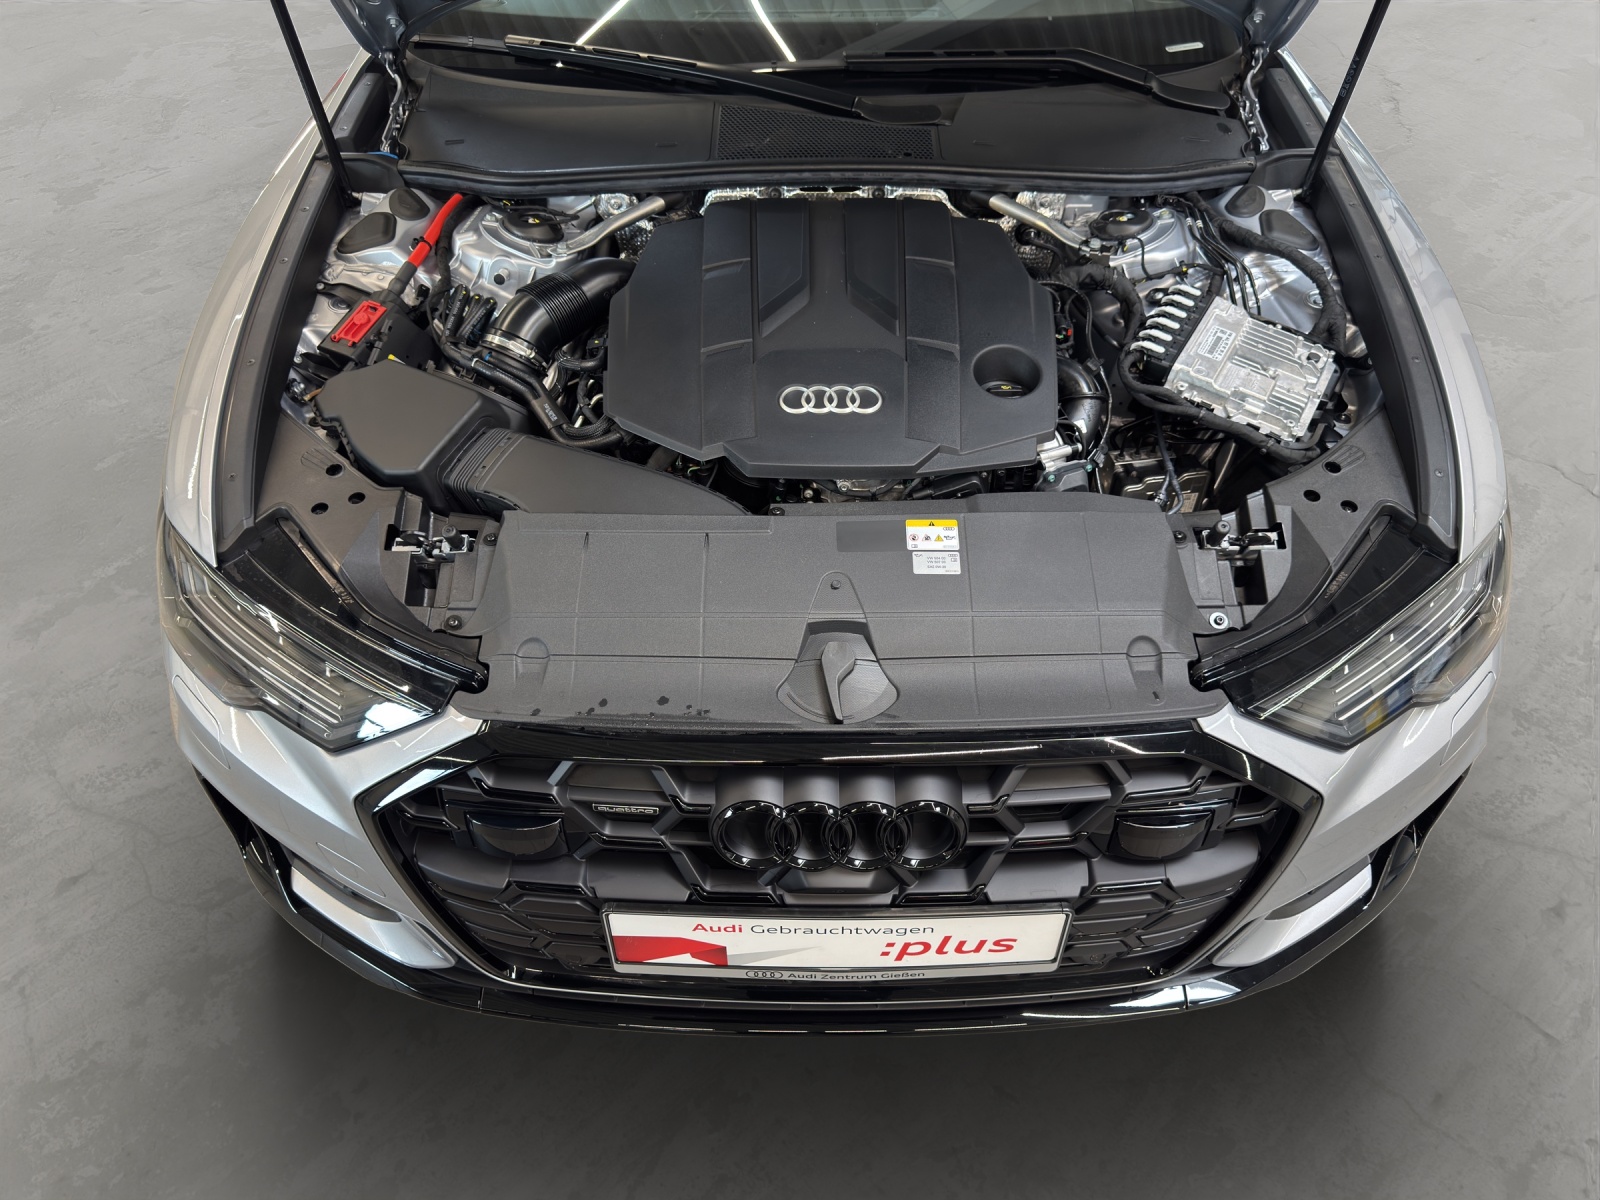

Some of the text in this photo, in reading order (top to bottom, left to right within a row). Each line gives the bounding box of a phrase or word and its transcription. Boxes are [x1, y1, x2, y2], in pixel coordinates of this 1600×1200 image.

[597, 806, 654, 814] quattro
[691, 923, 934, 937] Audi Gebrauchtwagen
[787, 972, 817, 980] Audi
[881, 972, 925, 980] Gießen
